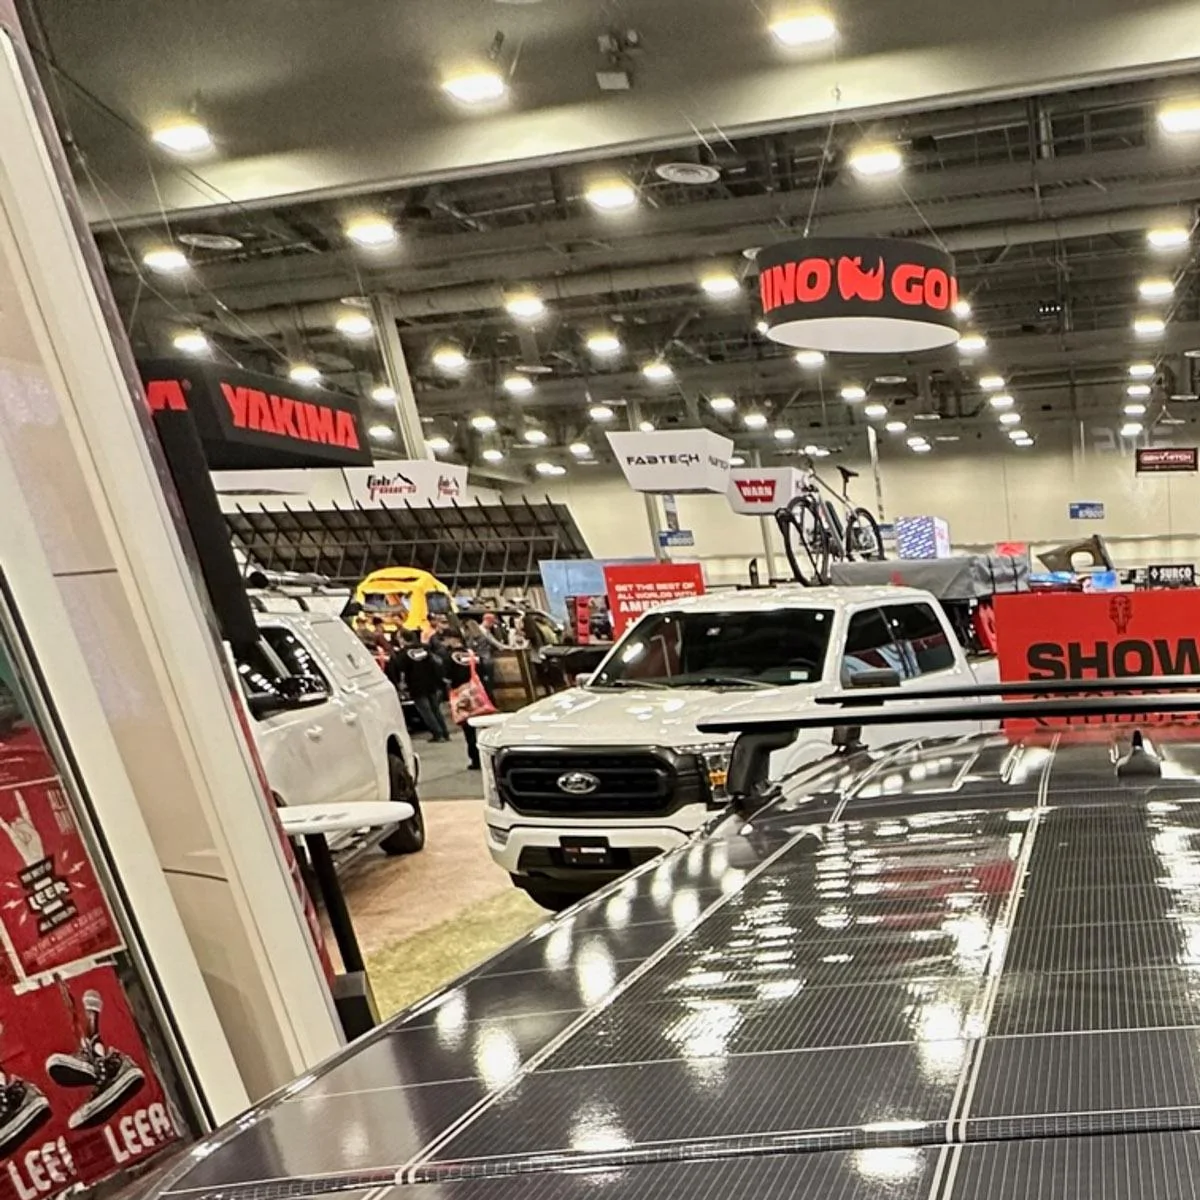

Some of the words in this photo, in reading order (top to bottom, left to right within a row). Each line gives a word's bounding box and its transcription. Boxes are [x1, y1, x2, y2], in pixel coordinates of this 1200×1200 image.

[220, 382, 360, 450] YAKIMA
[626, 454, 699, 467] FABTECH
[1160, 567, 1192, 580] SURCO
